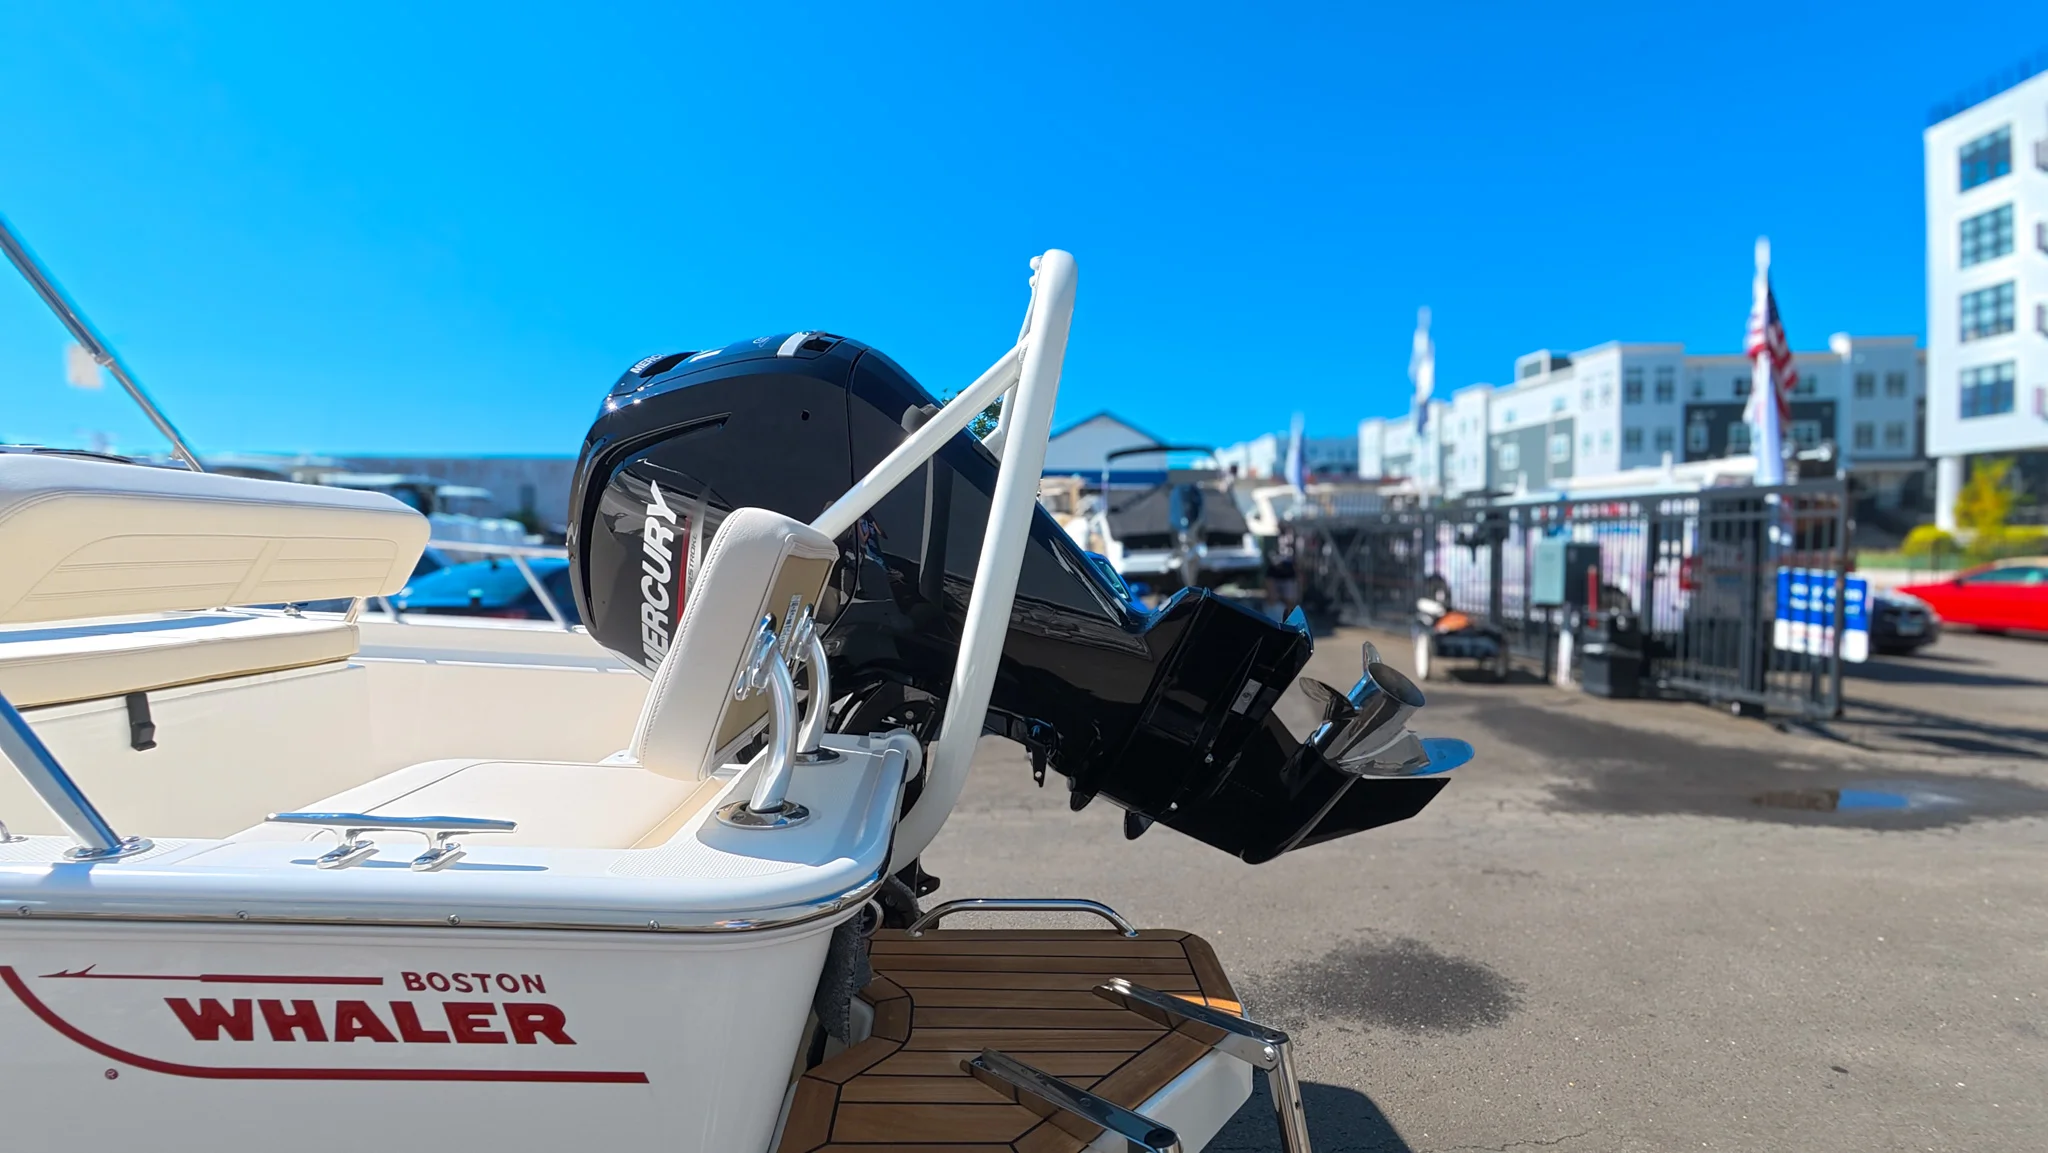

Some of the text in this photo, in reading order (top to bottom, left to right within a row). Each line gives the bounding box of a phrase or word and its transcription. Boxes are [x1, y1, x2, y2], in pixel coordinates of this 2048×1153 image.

[629, 354, 664, 374] MERC
[640, 479, 677, 672] MERCURY
[401, 971, 547, 994] BOSTON
[163, 997, 578, 1045] WHALER
